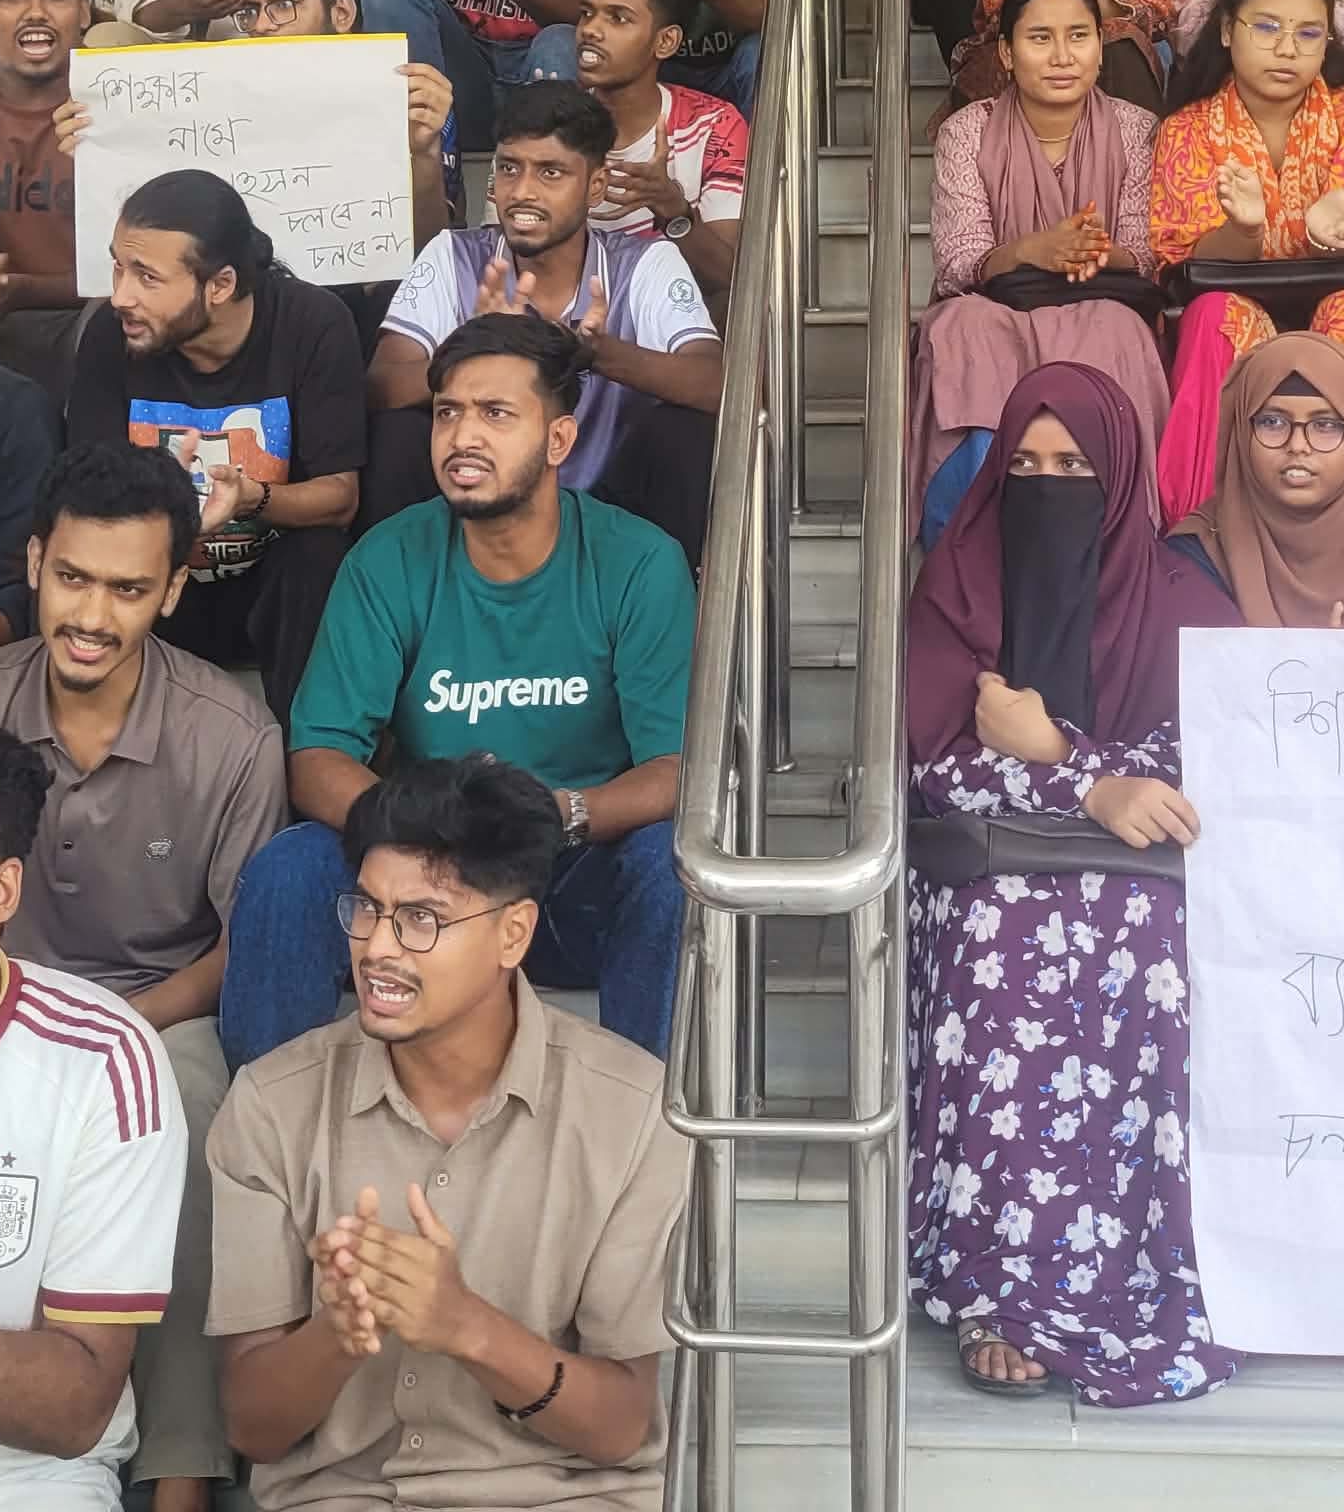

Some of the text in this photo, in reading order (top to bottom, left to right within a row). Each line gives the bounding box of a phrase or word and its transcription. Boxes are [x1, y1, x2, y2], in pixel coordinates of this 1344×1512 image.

[87, 66, 208, 114] শিক্ষার
[167, 116, 253, 158] নামে
[279, 191, 409, 234] চলবে না
[306, 231, 411, 272] চলবে না
[424, 668, 589, 724] Supreme
